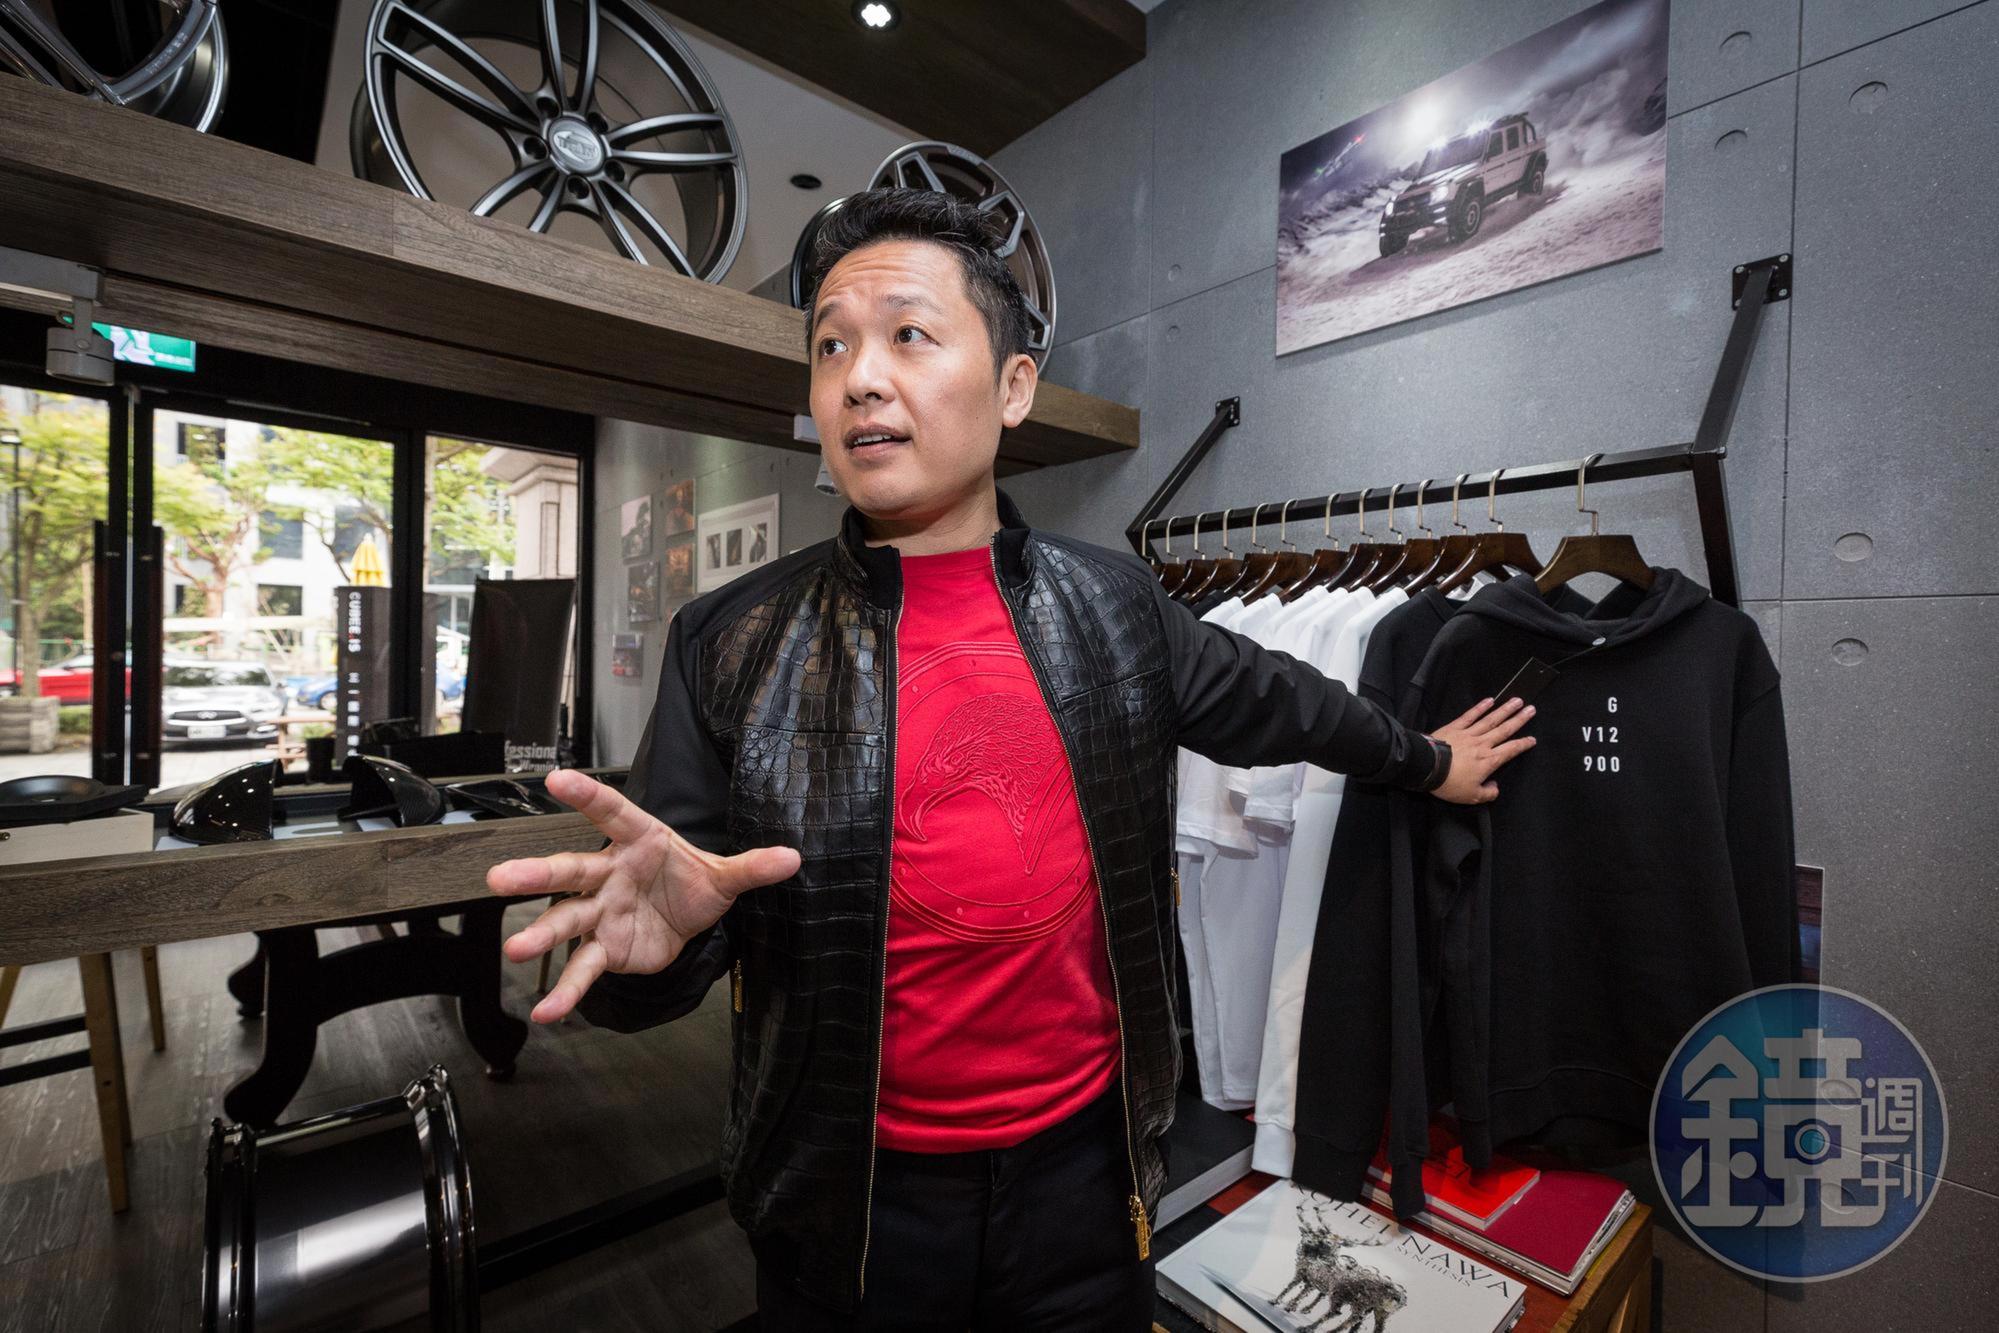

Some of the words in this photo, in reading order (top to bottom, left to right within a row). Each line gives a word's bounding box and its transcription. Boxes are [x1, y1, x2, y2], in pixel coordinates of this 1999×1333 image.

[1607, 696, 1618, 713] G
[1582, 726, 1619, 743] V12
[1583, 755, 1620, 773] 900
[1395, 1245, 1471, 1288] SYNTHESIS
[1402, 1235, 1509, 1299] NAWA
